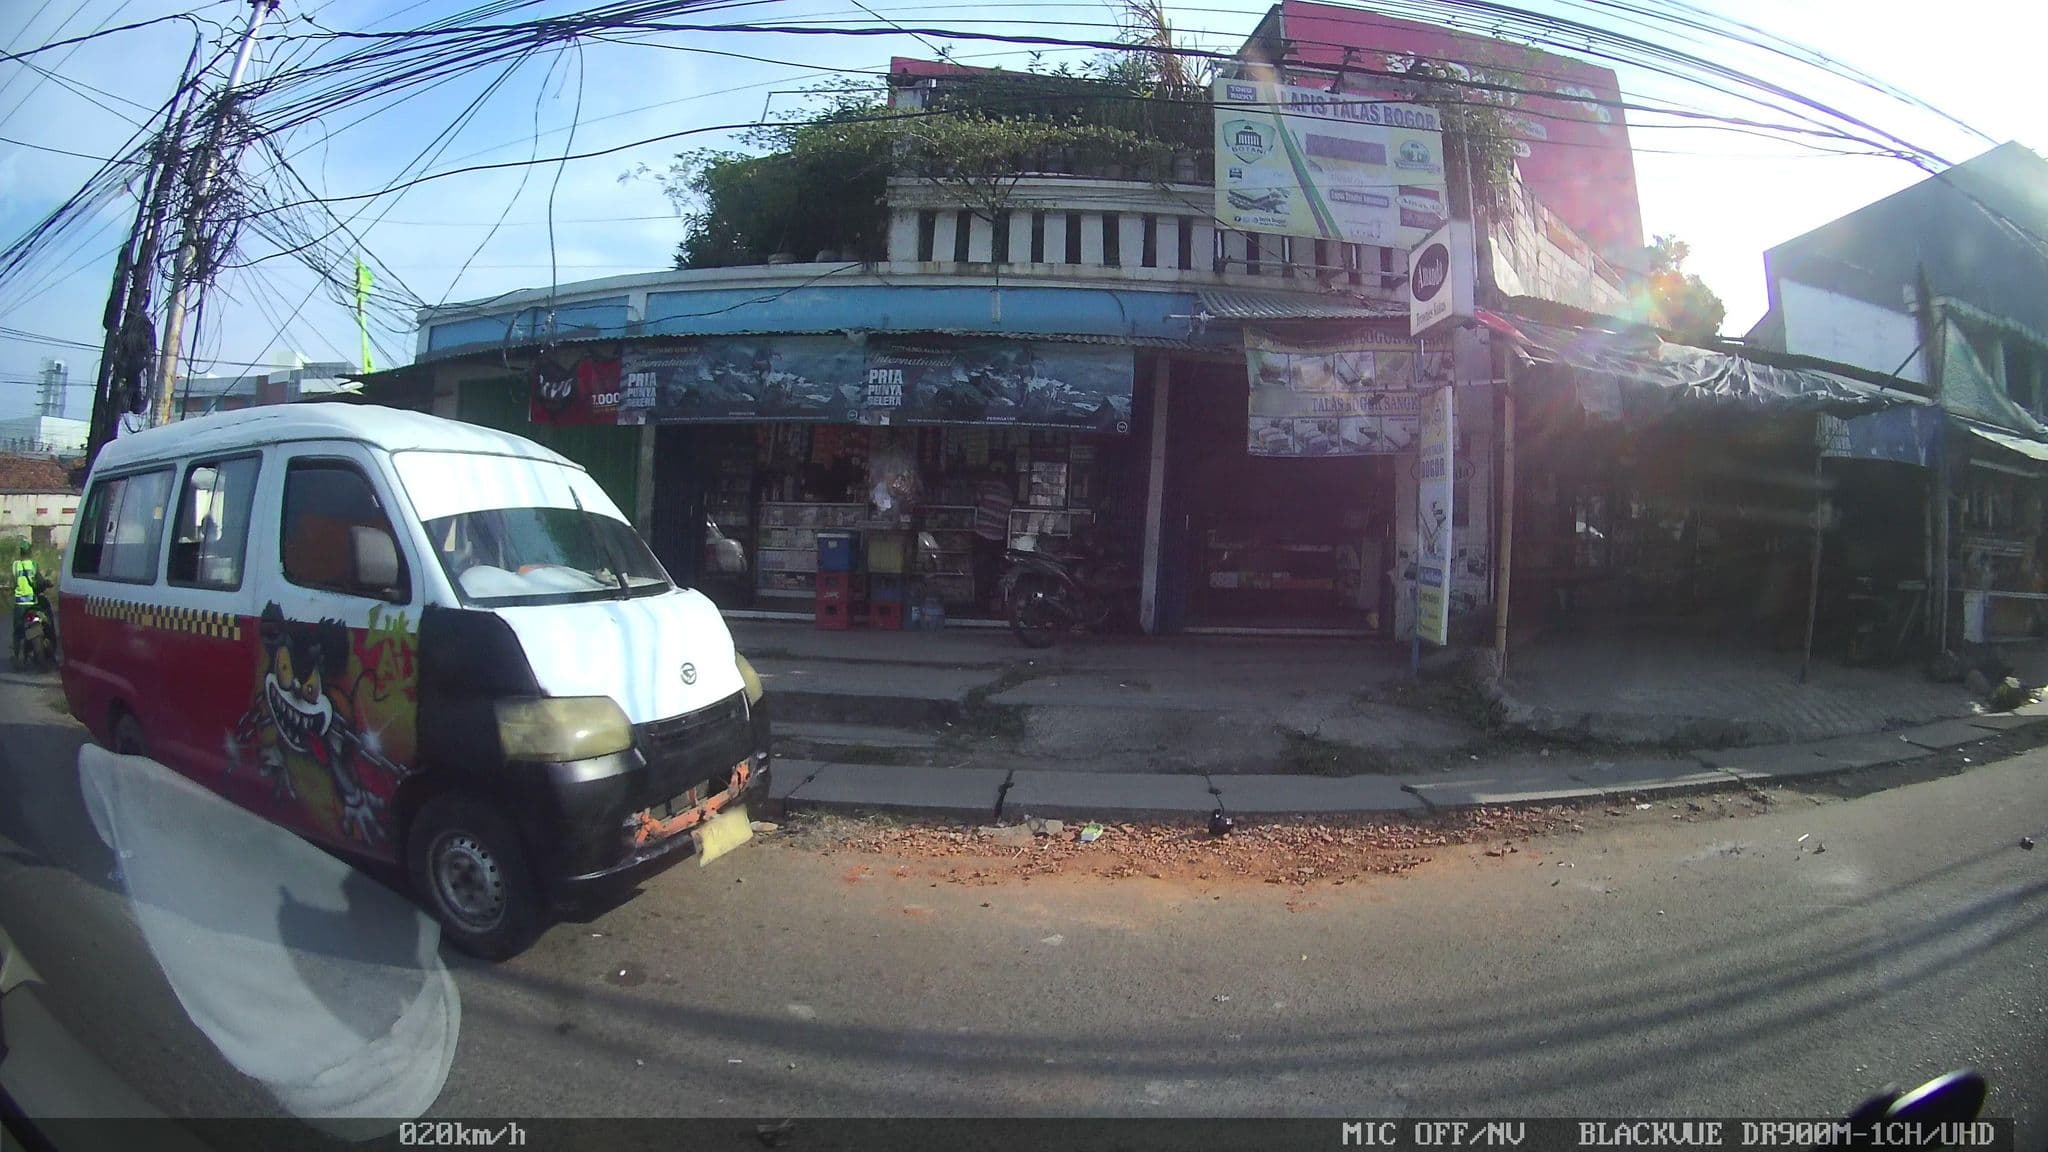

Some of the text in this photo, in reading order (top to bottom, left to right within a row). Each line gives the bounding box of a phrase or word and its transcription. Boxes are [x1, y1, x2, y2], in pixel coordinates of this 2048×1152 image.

[1281, 90, 1436, 131] LAPIS TALAS BOGOR
[871, 352, 957, 368] International
[628, 372, 657, 387] PRIA
[868, 369, 903, 385] PRIA
[627, 387, 657, 398] PUNYA
[867, 384, 903, 396] PUNYA
[591, 392, 620, 405] 1.000
[866, 395, 902, 406] SELERA
[1312, 396, 1344, 412] TALAS
